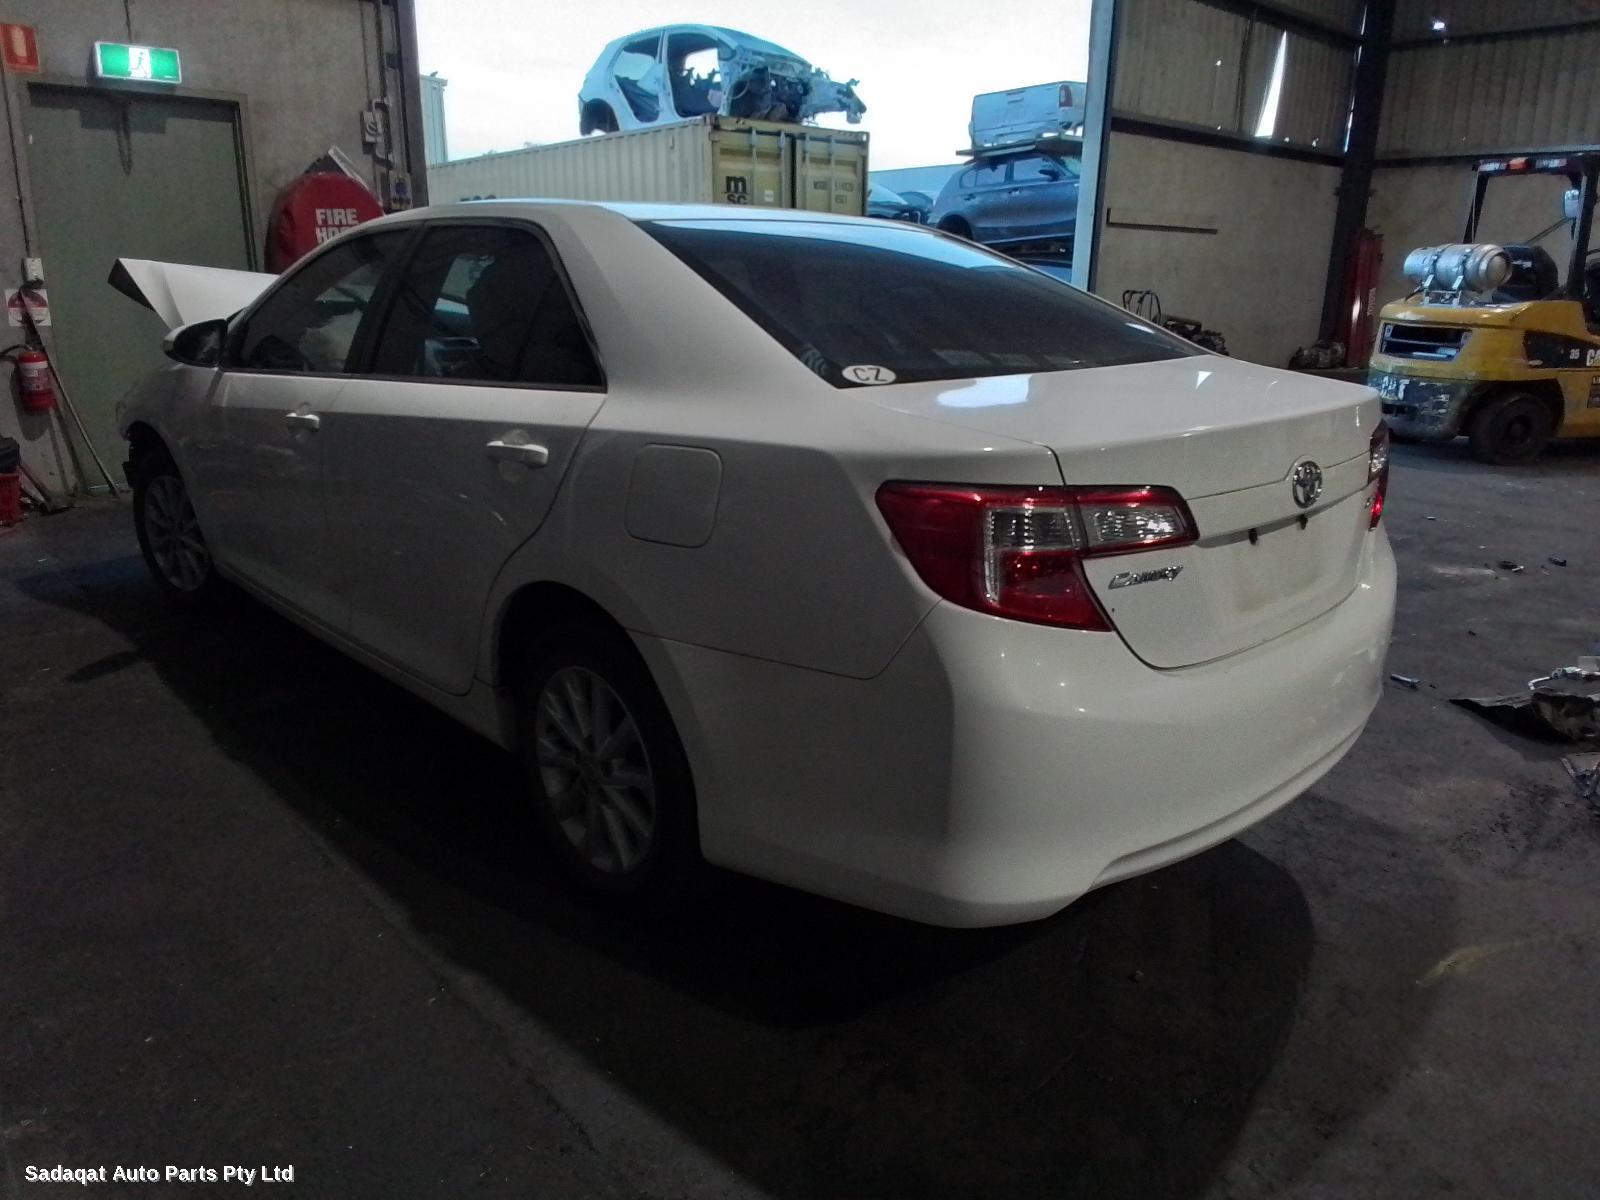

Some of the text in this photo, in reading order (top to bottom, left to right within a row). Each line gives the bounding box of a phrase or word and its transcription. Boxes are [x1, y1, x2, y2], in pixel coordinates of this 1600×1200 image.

[315, 208, 358, 225] FIRE
[315, 226, 351, 244] HO
[852, 367, 888, 382] CZ
